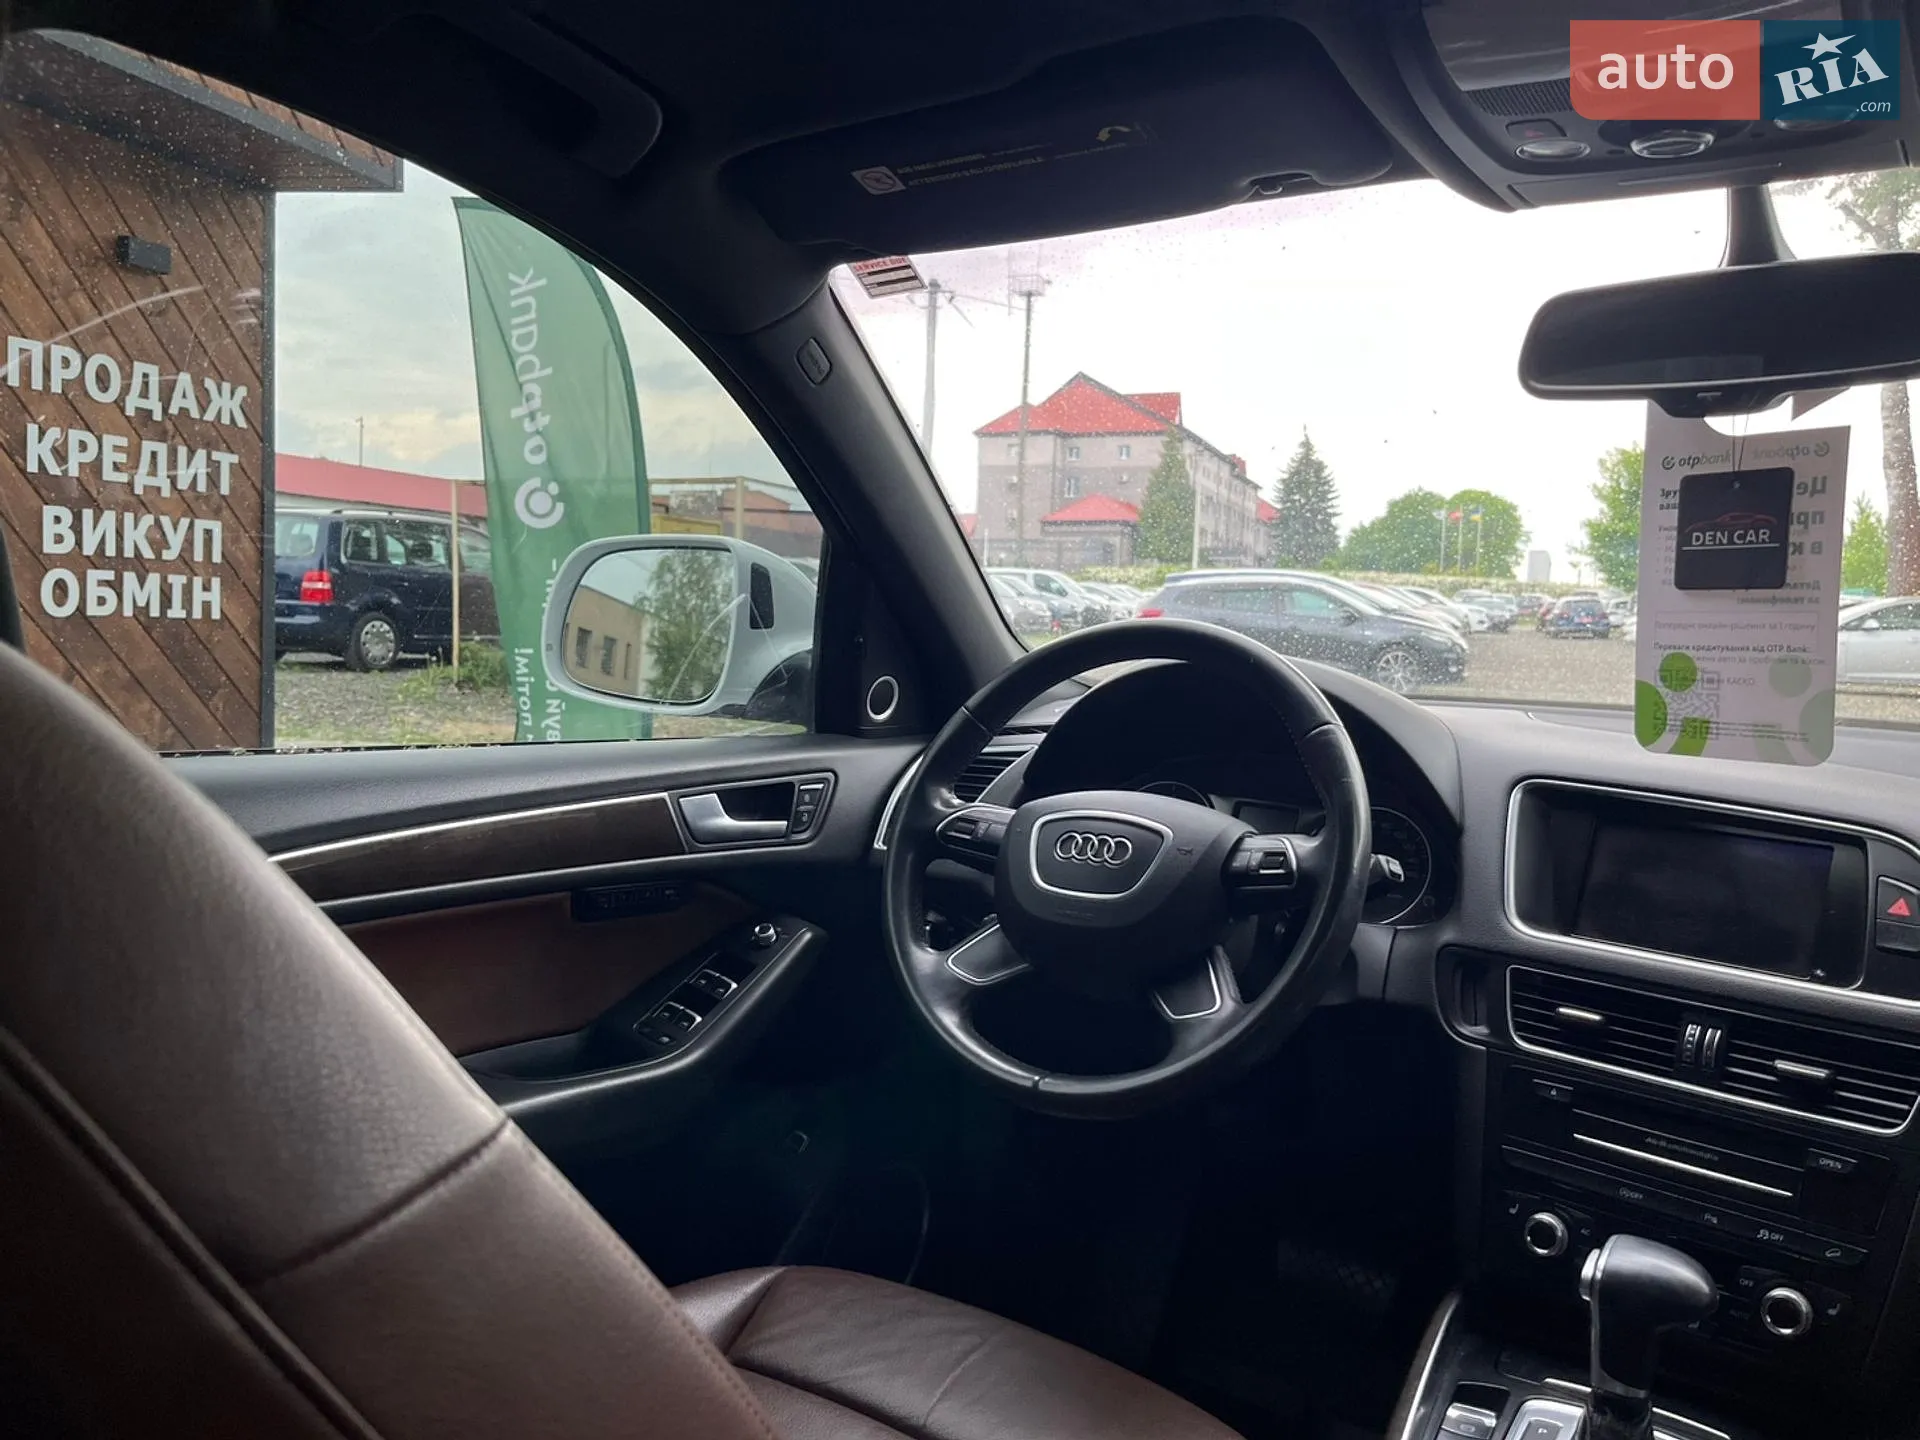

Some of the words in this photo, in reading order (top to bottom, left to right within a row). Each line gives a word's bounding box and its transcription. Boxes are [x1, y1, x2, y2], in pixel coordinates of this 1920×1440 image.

[7, 335, 249, 430] ПРОДАЖ
[26, 422, 240, 498] КРЕДИТ
[1678, 449, 1731, 469] otpbank
[42, 505, 223, 564] ВИКУП
[1691, 530, 1729, 546] DEN
[1732, 528, 1771, 545] CAR
[40, 567, 222, 620] ОБМІН
